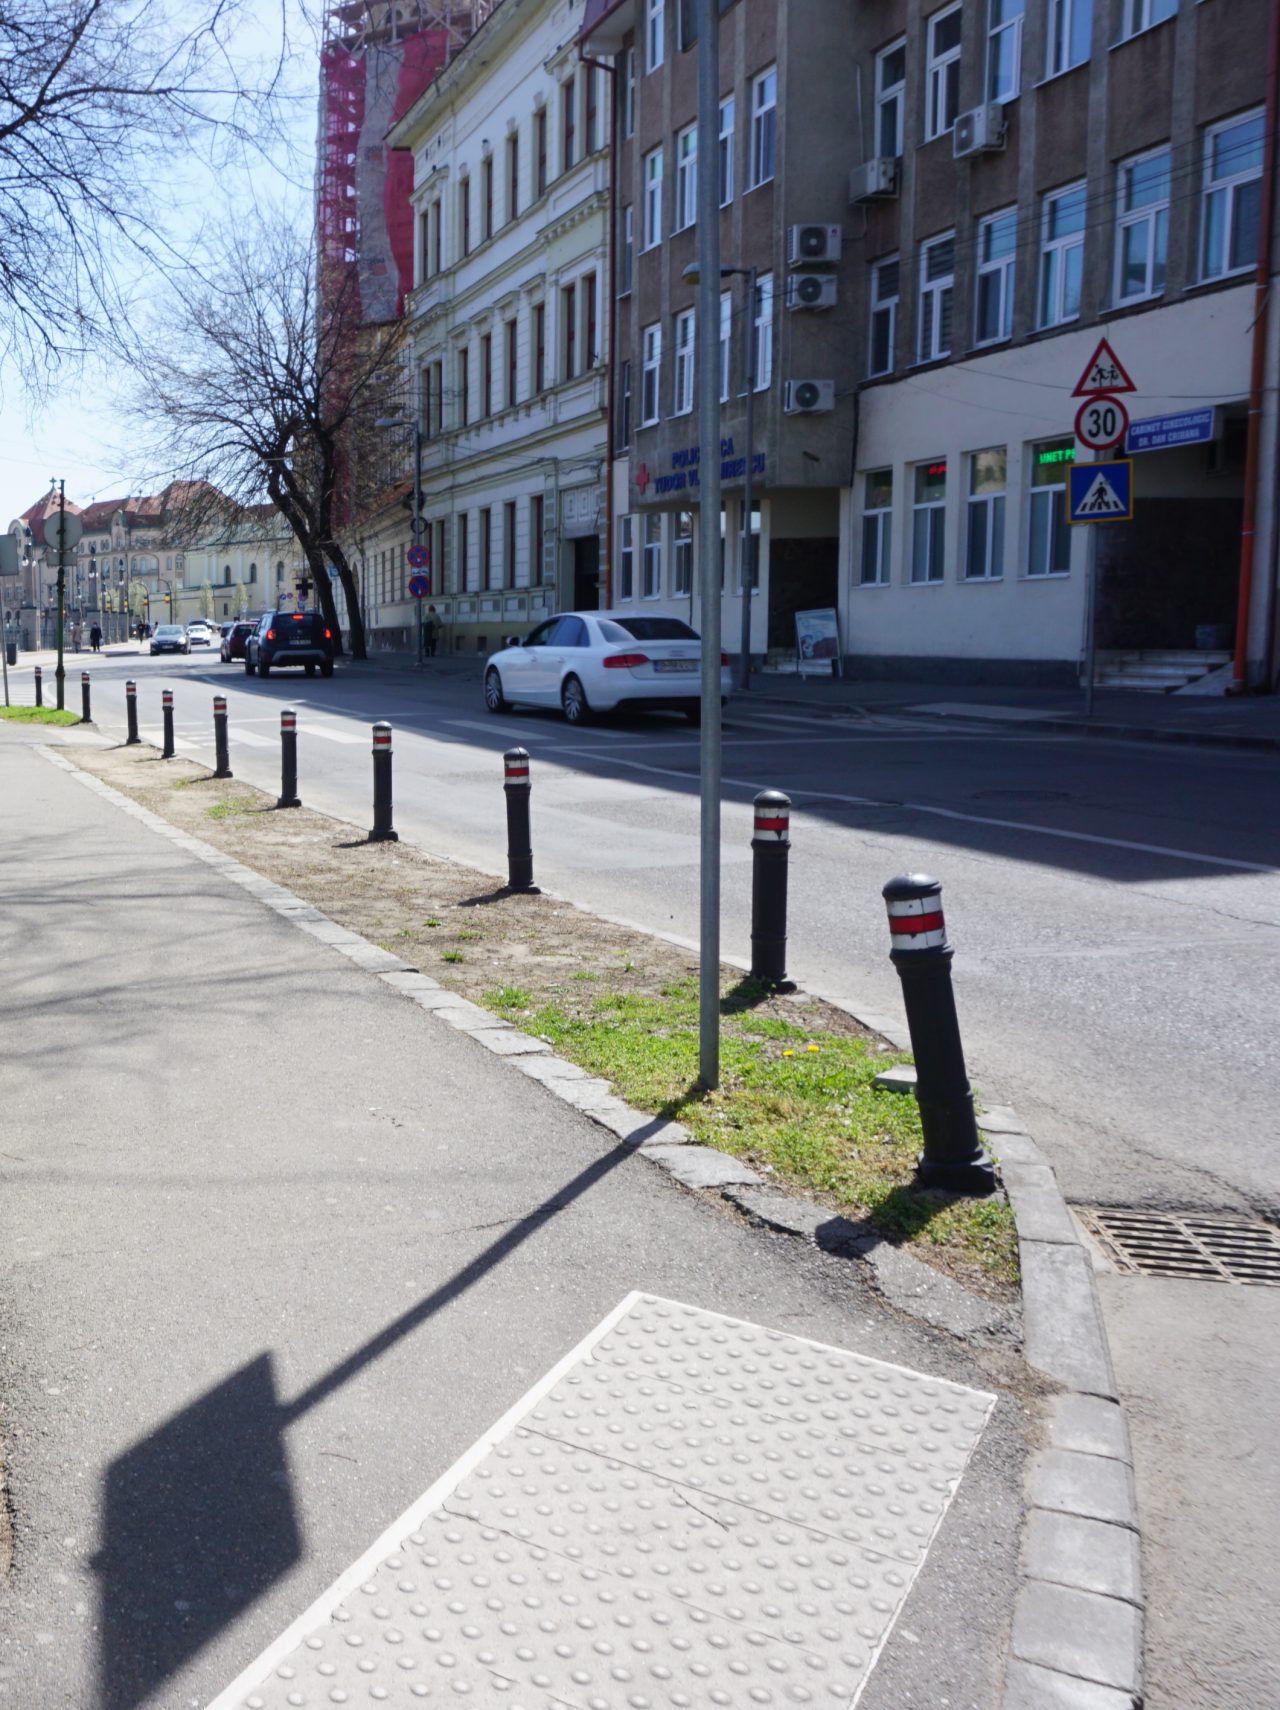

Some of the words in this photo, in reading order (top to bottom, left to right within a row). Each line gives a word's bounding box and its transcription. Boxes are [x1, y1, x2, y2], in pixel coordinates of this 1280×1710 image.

[1088, 408, 1116, 438] 30
[1131, 422, 1161, 436] CABINET
[672, 437, 734, 469] POLICCA
[654, 471, 686, 494] TUDOR
